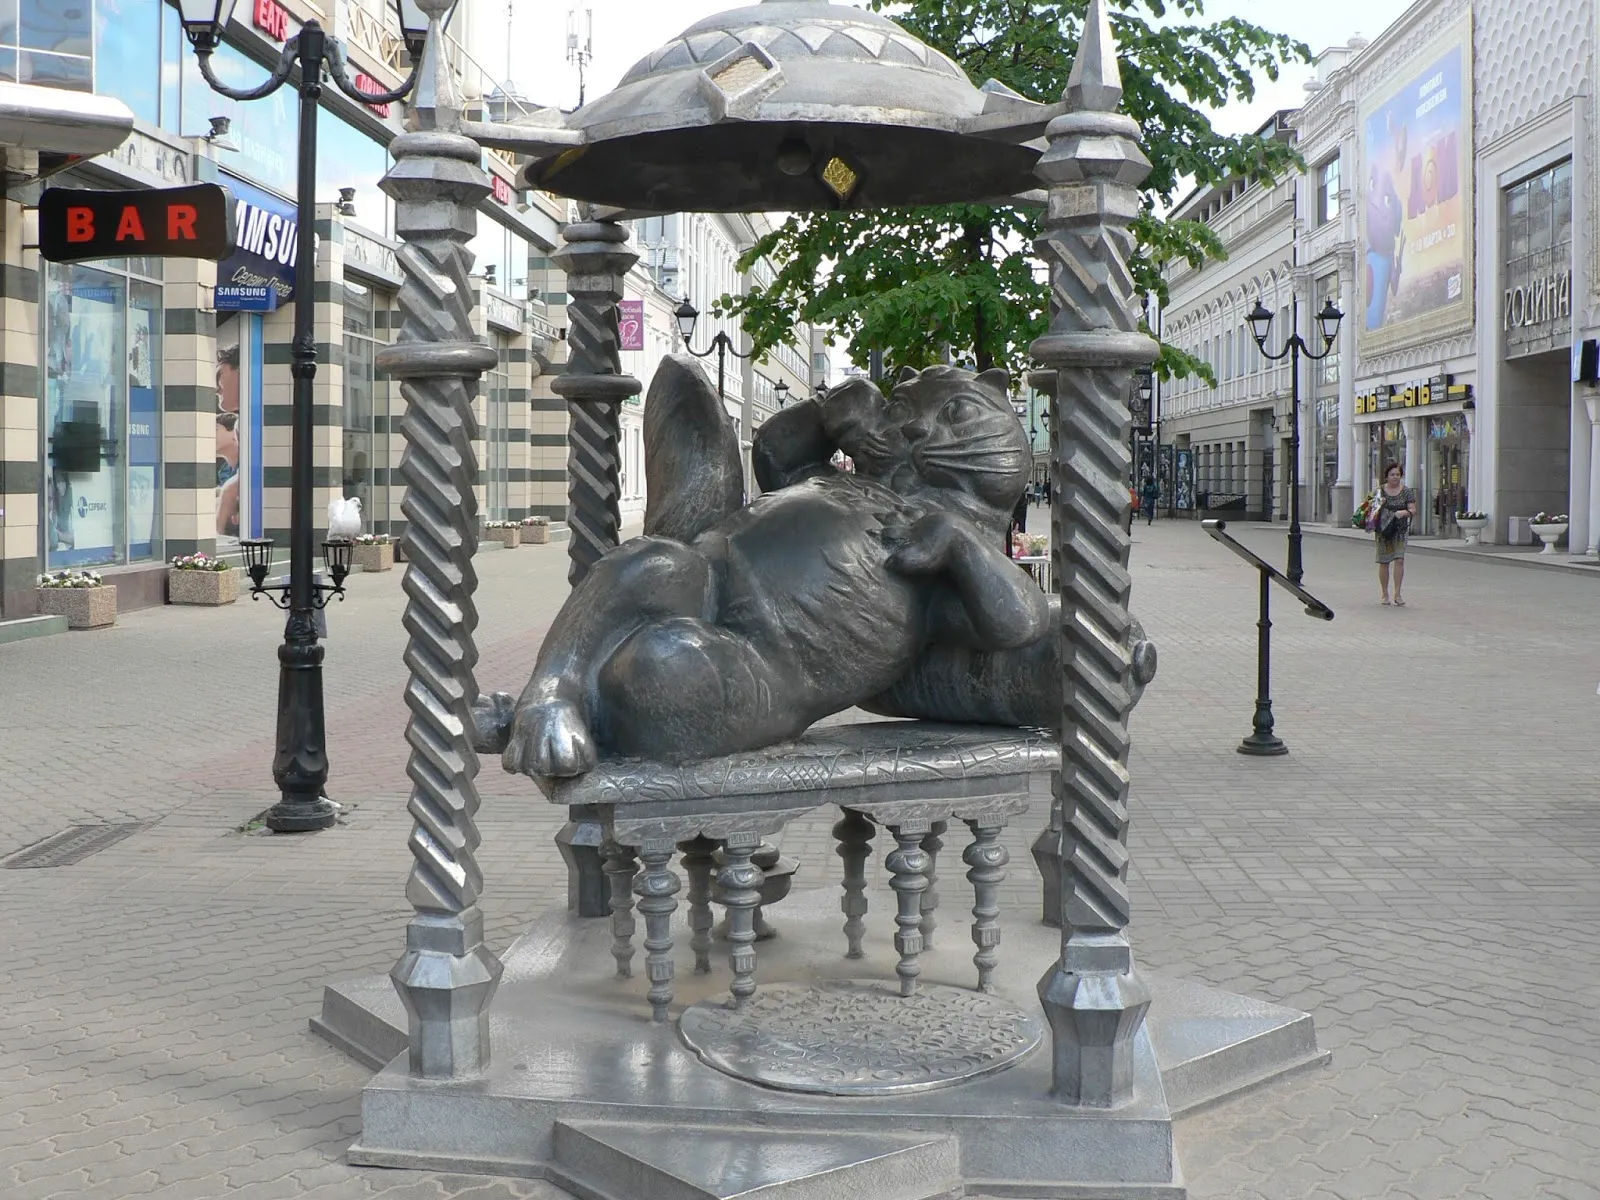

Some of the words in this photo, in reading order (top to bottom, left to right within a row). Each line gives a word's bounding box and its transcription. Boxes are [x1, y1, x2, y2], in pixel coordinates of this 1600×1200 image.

[256, 0, 289, 42] EATS
[66, 205, 197, 242] BAR
[217, 287, 267, 297] SAMSUNG
[1505, 270, 1569, 331] РОДИНА
[128, 423, 149, 435] SUNG
